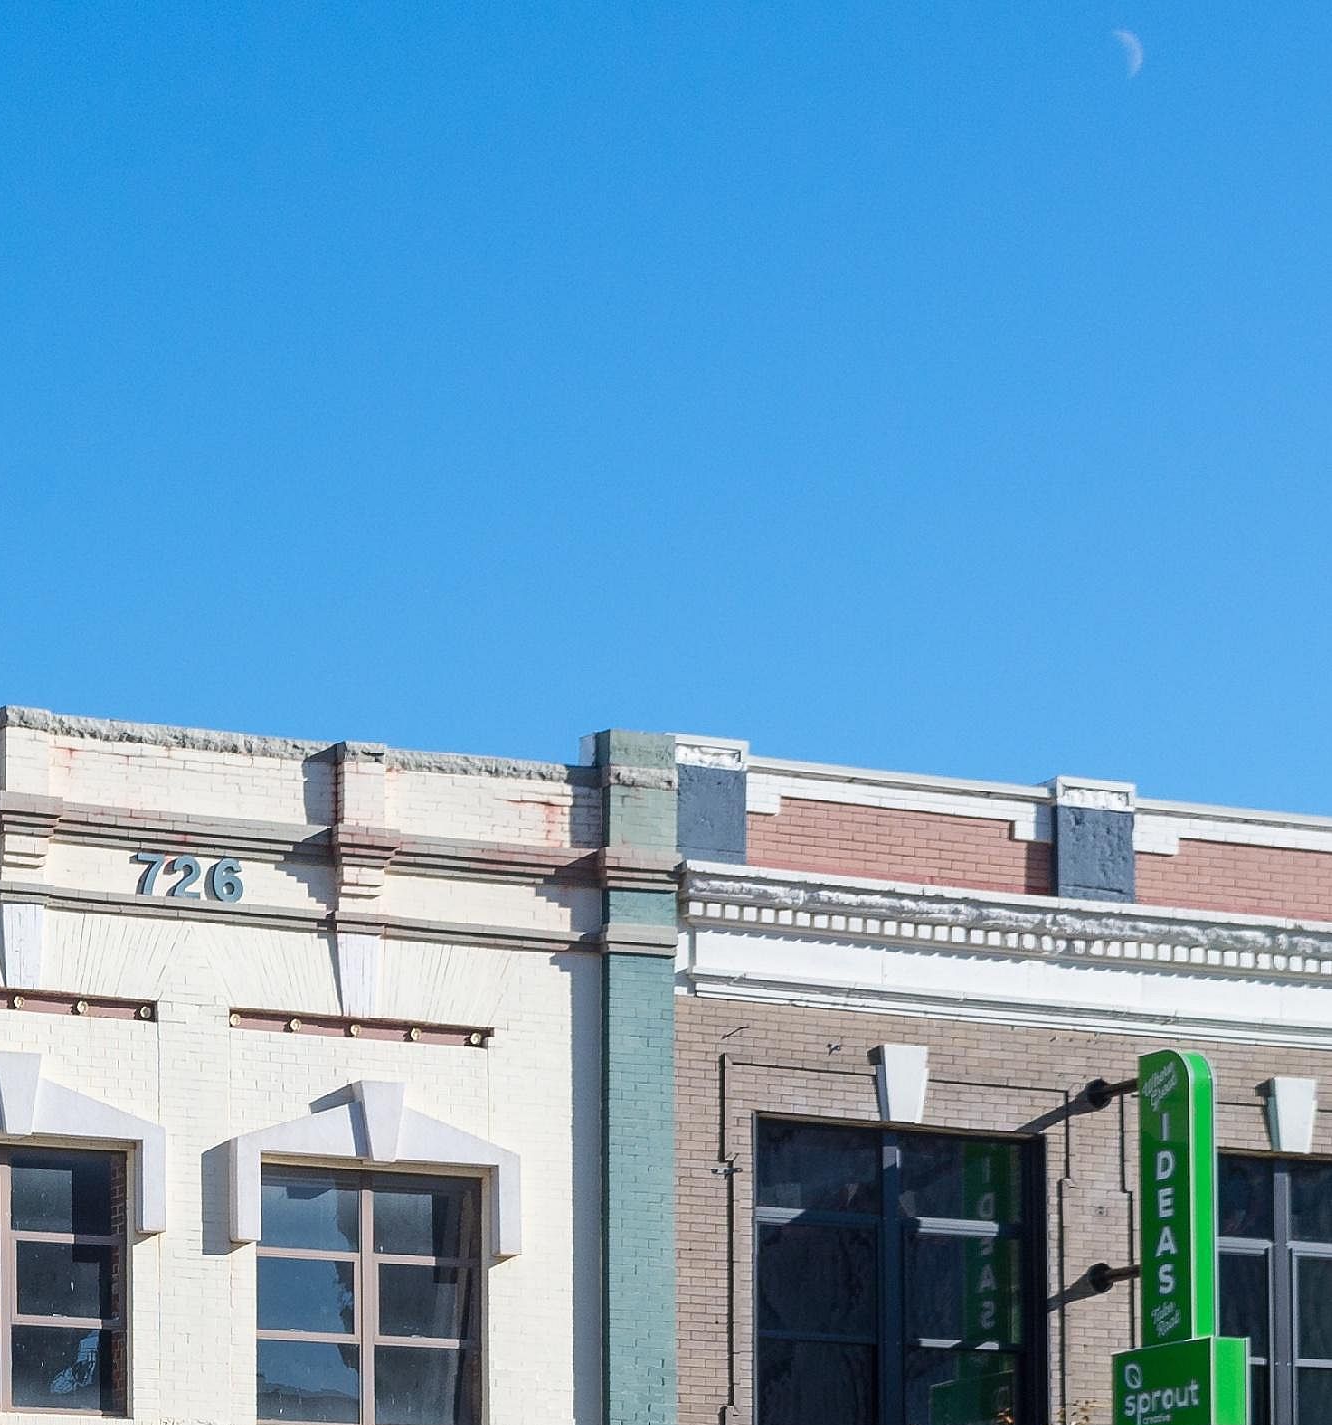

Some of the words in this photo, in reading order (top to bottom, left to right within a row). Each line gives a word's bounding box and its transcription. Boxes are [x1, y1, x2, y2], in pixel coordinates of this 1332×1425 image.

[129, 851, 244, 904] 726
[1155, 1112, 1178, 1295] IDEAS
[1124, 1379, 1199, 1425] sprout
